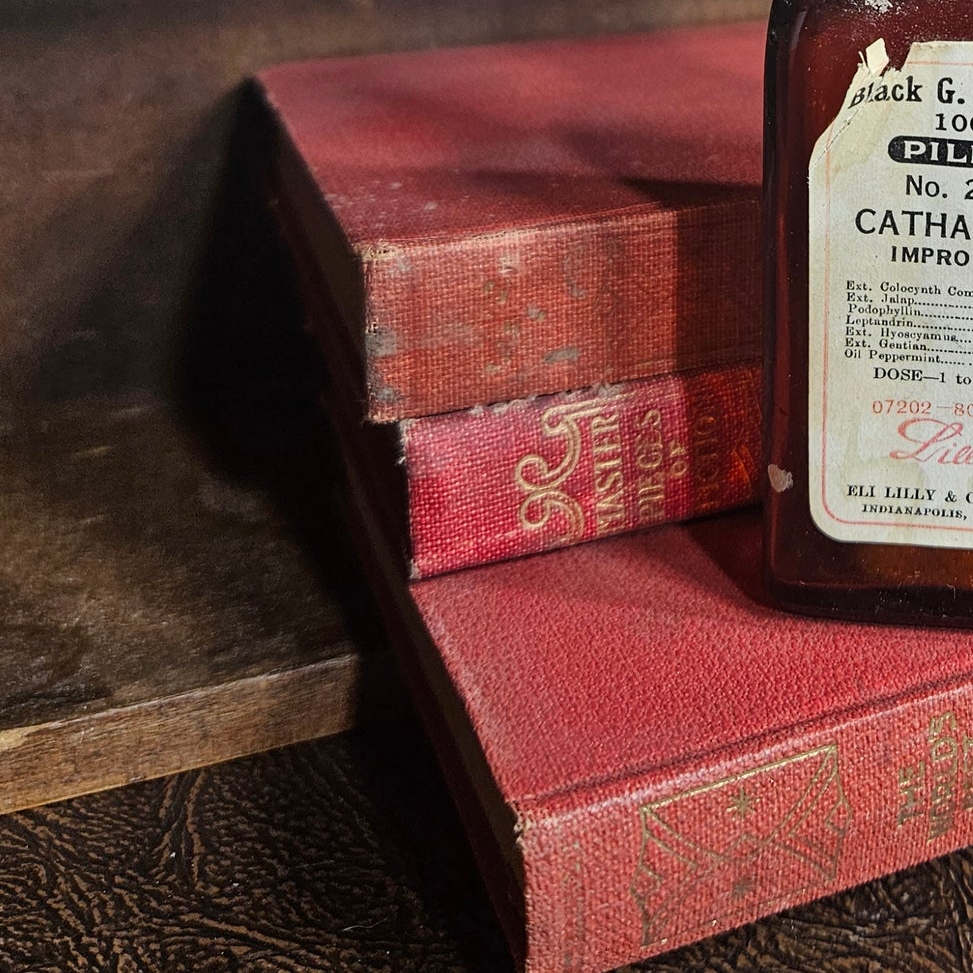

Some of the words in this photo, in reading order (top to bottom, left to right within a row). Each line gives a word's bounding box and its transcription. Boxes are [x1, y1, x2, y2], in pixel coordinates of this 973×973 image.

[848, 75, 923, 109] Black
[937, 77, 966, 104] G.
[905, 175, 948, 199] No.
[846, 280, 872, 291] Ext.
[880, 281, 941, 295] Colocynth
[847, 292, 873, 302] Ext.
[845, 326, 871, 337] Ext.
[845, 338, 871, 348] Ext.
[844, 349, 861, 358] Oil
[956, 373, 972, 385] to
[847, 484, 876, 498] ELI
[885, 486, 936, 501] LILLY
[944, 491, 957, 503] &
[862, 503, 967, 521] INDIANAPOLIS,
